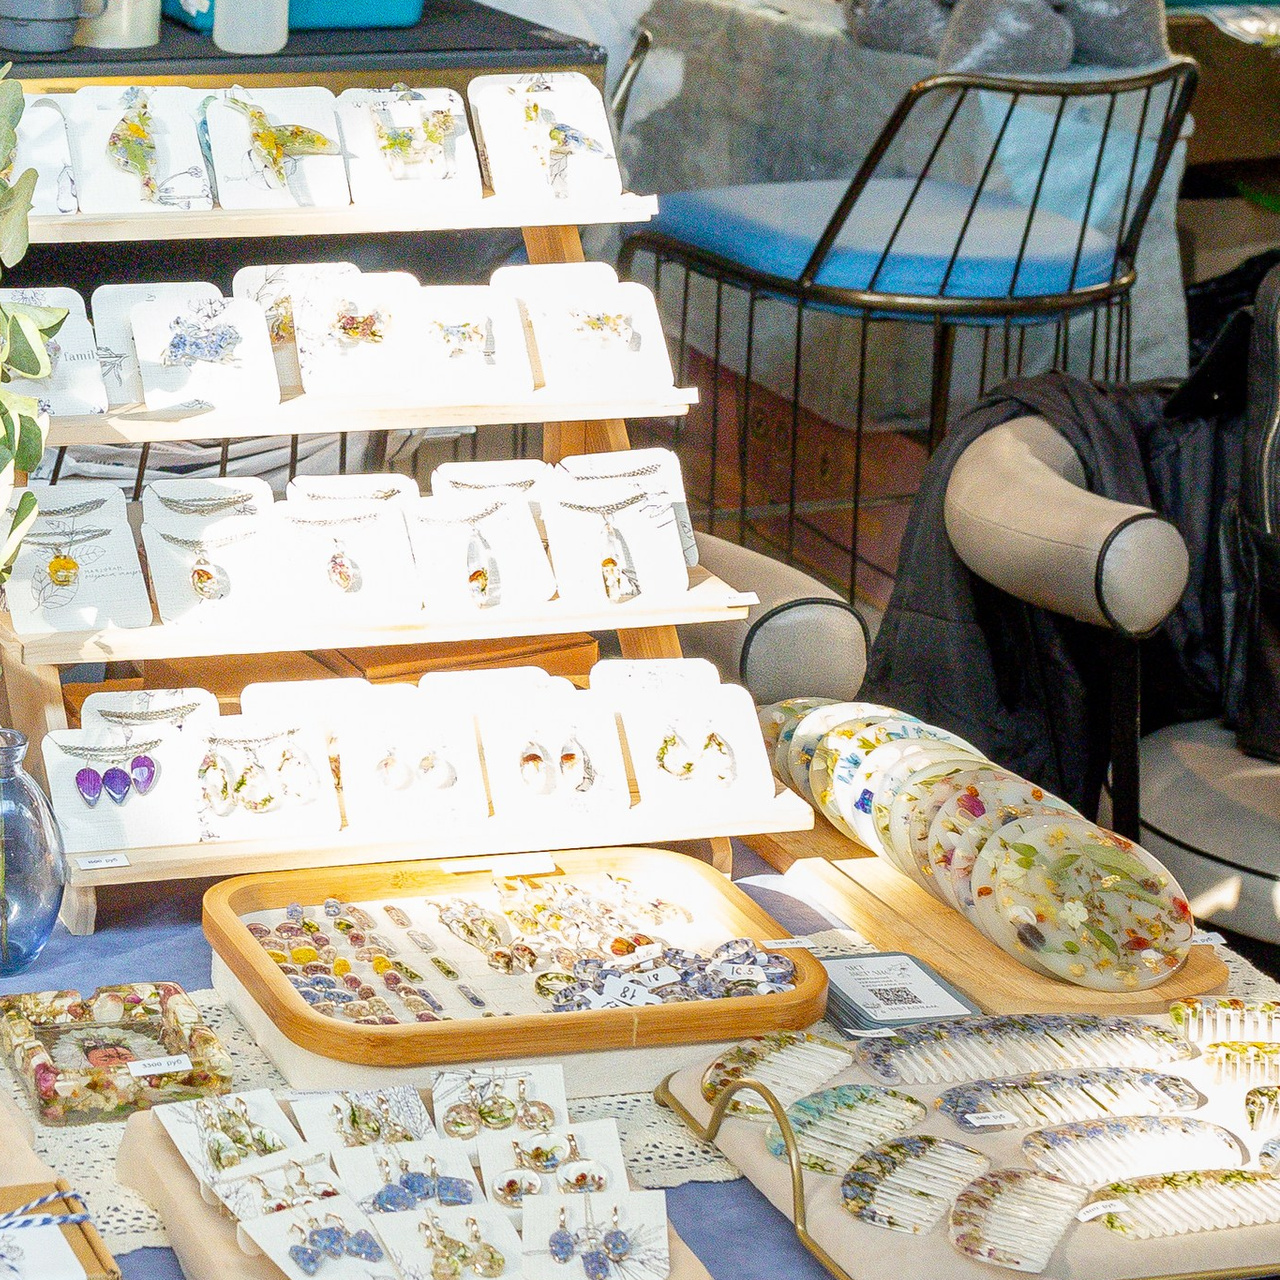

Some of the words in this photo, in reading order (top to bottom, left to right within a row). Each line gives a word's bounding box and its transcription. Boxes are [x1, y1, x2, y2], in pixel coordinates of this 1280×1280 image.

[646, 972, 660, 983] 18
[619, 985, 637, 1000] 18
[166, 1058, 183, 1067] руб
